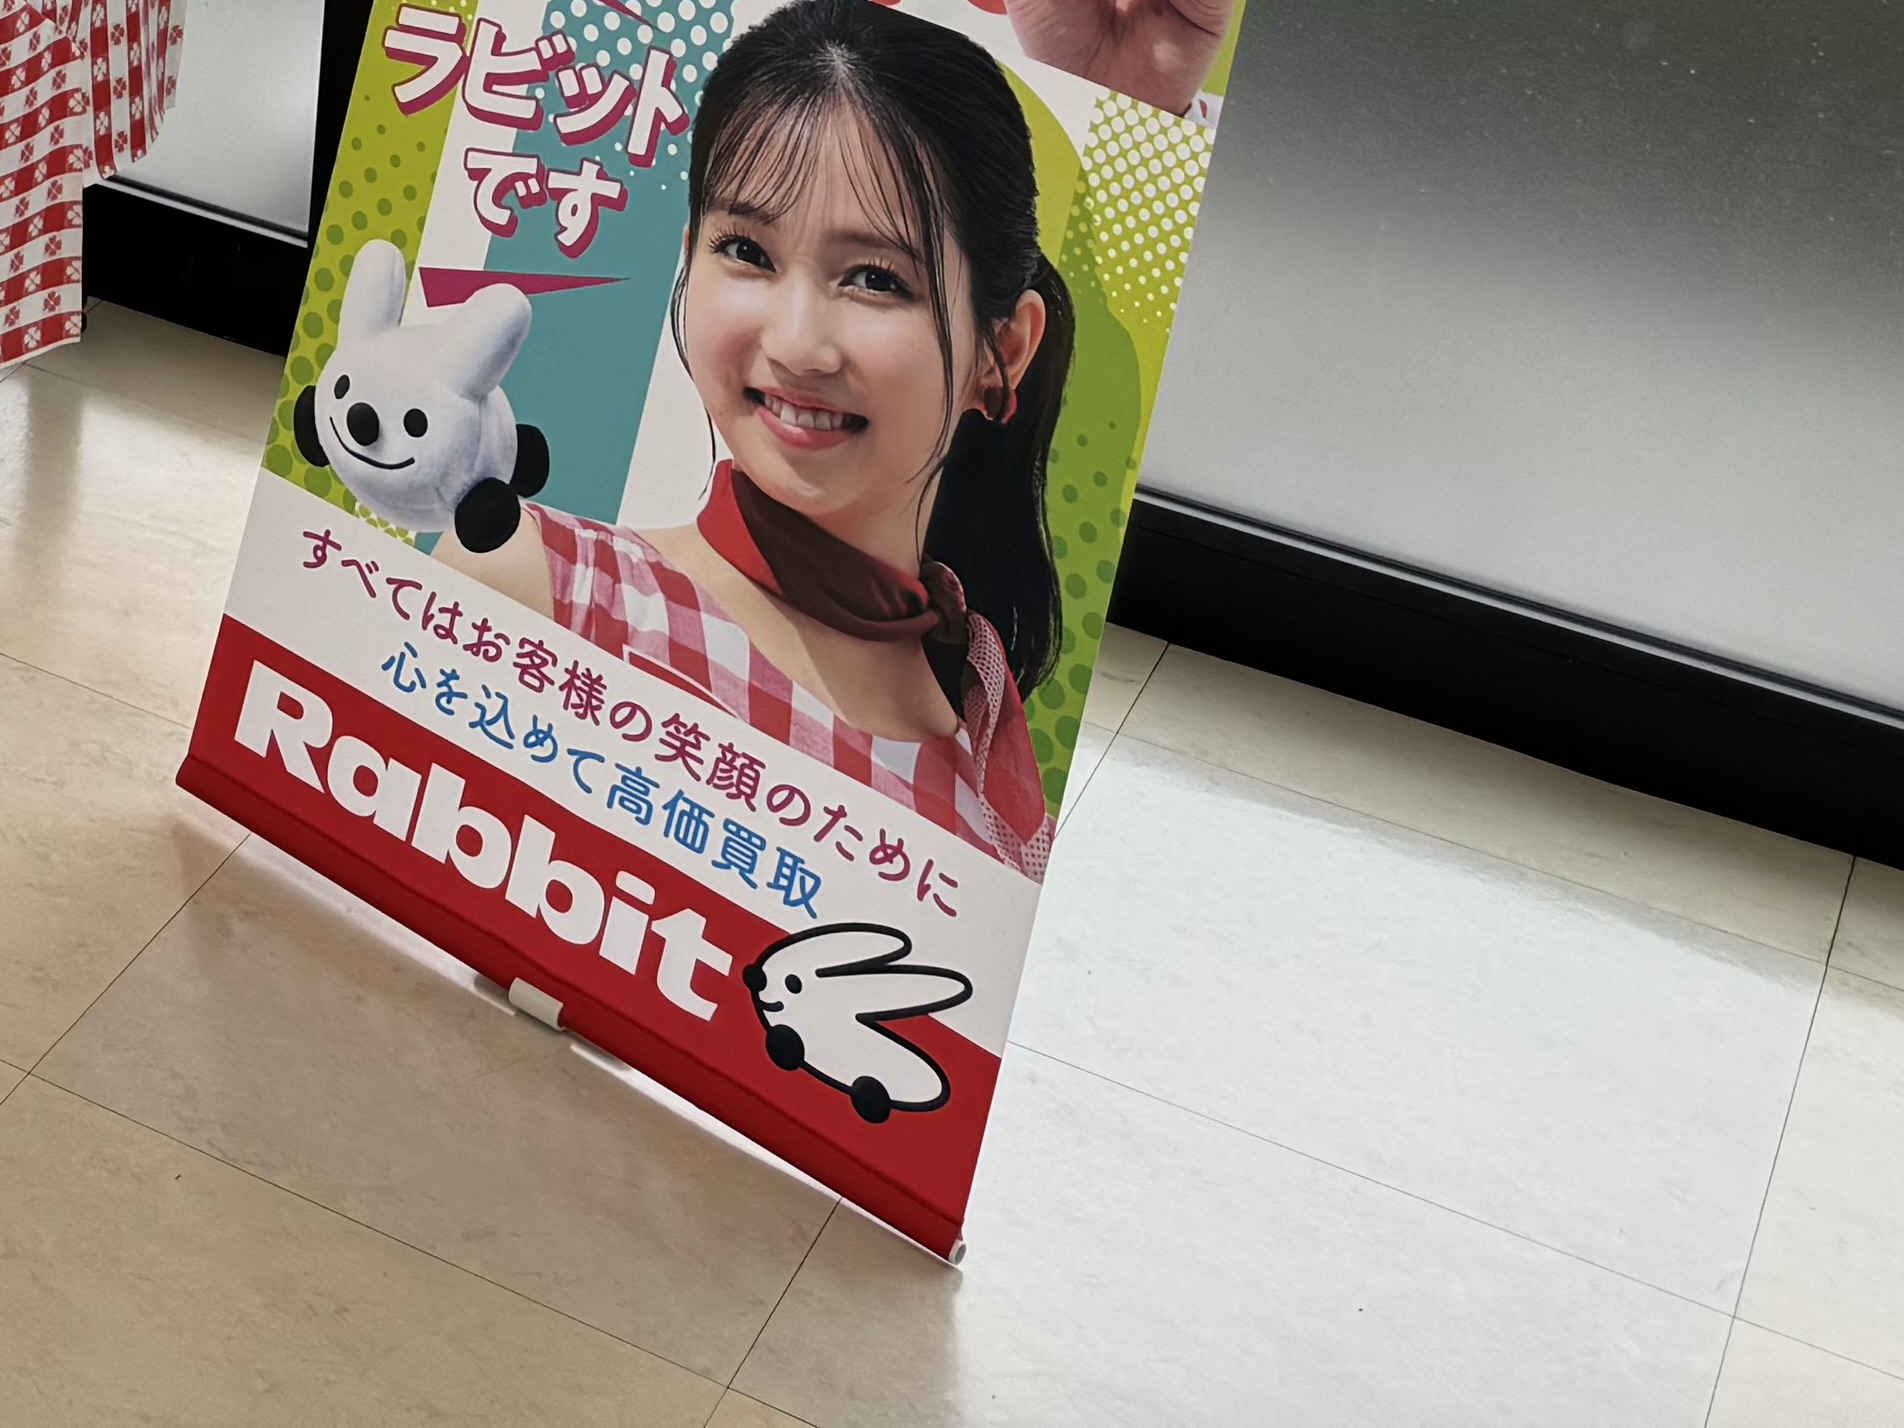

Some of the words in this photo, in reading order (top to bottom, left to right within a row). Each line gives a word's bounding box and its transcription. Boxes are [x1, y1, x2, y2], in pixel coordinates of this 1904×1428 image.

[382, 4, 690, 169] ラビット
[465, 146, 629, 260] です
[234, 660, 736, 1021] Rabbit
[302, 527, 961, 920] すべてはお客様の笑顔のために
[381, 644, 822, 920] 心を込めて高価買取
